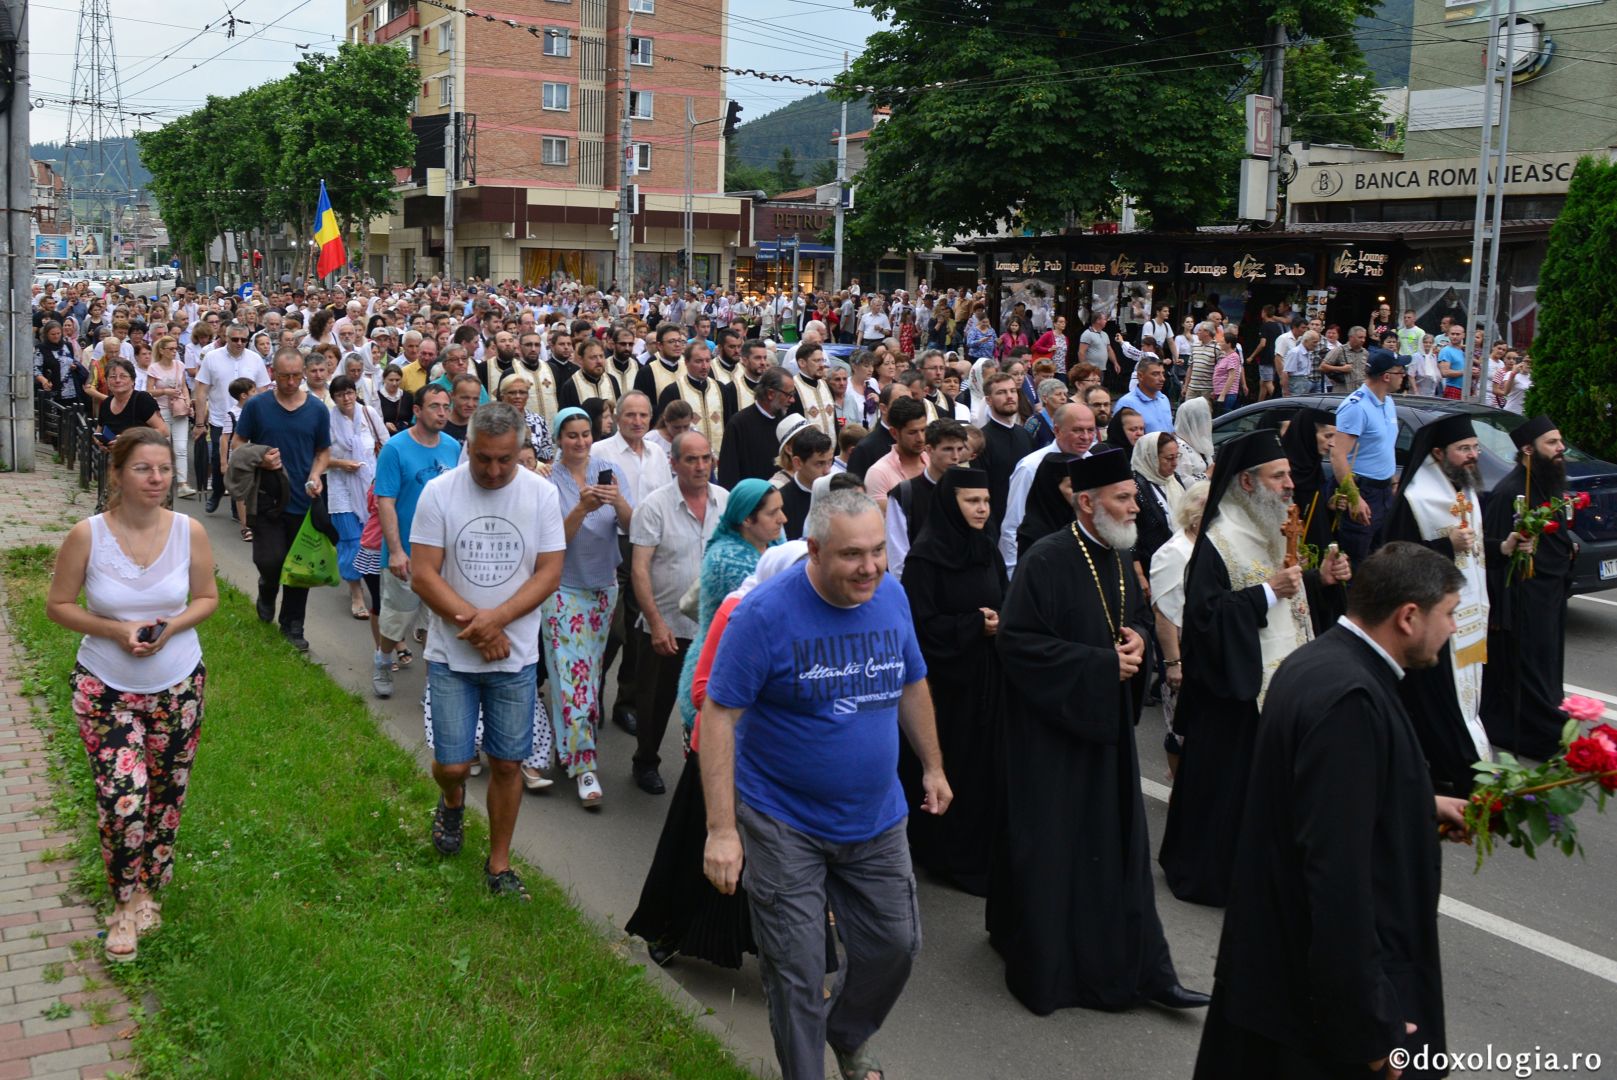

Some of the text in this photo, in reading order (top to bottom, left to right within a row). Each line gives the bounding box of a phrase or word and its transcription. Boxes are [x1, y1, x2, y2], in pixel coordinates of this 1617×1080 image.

[1355, 170, 1421, 190] BANCA
[1359, 250, 1389, 264] Lounge
[995, 260, 1019, 271] Lounge
[1044, 260, 1062, 271] Pub
[1071, 261, 1106, 275] Lounge
[1143, 262, 1169, 274] Pub
[1184, 262, 1227, 277] Lounge
[1274, 263, 1306, 276] Pub
[1364, 264, 1384, 277] Pub
[484, 522, 495, 531] NY
[461, 539, 519, 551] NEW YORK
[470, 551, 509, 559] BROOKLYN
[464, 563, 490, 571] CASUAL
[480, 573, 496, 581] USA
[799, 657, 904, 680] Atlantic Crossing
